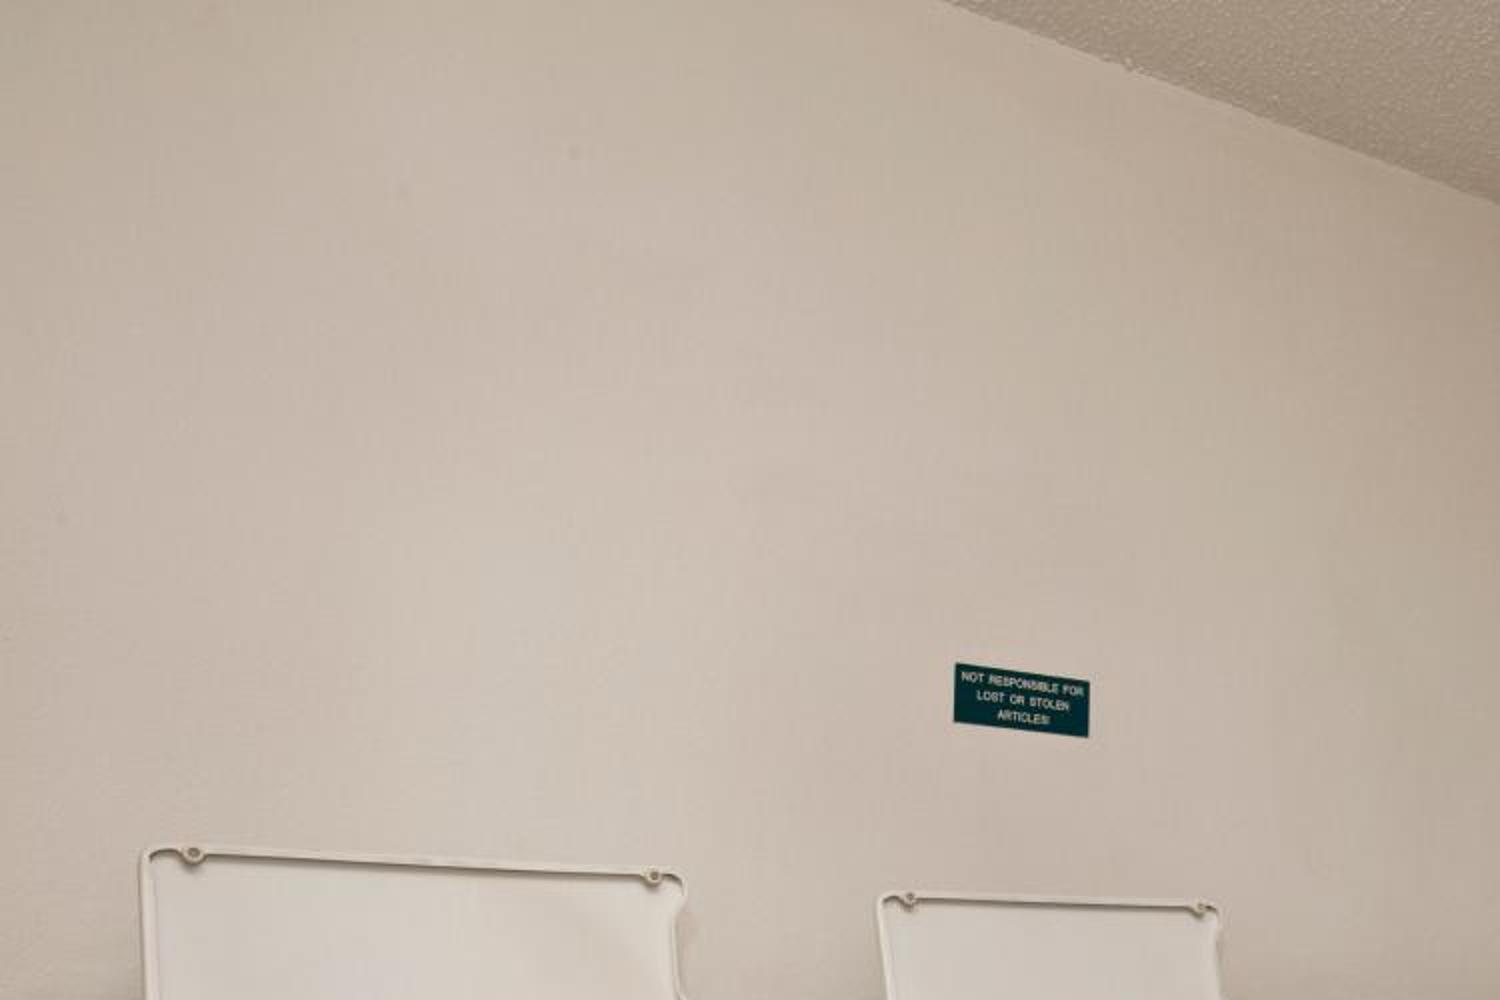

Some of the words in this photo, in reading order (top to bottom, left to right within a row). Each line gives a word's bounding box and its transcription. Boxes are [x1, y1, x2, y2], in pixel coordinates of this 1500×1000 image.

[961, 671, 985, 683] NOT
[988, 675, 1060, 695] RESPONSIBLE
[1062, 685, 1085, 697] FOR
[976, 689, 1004, 703] LOST
[1009, 694, 1025, 706] OR
[1029, 697, 1071, 711] STOLEN
